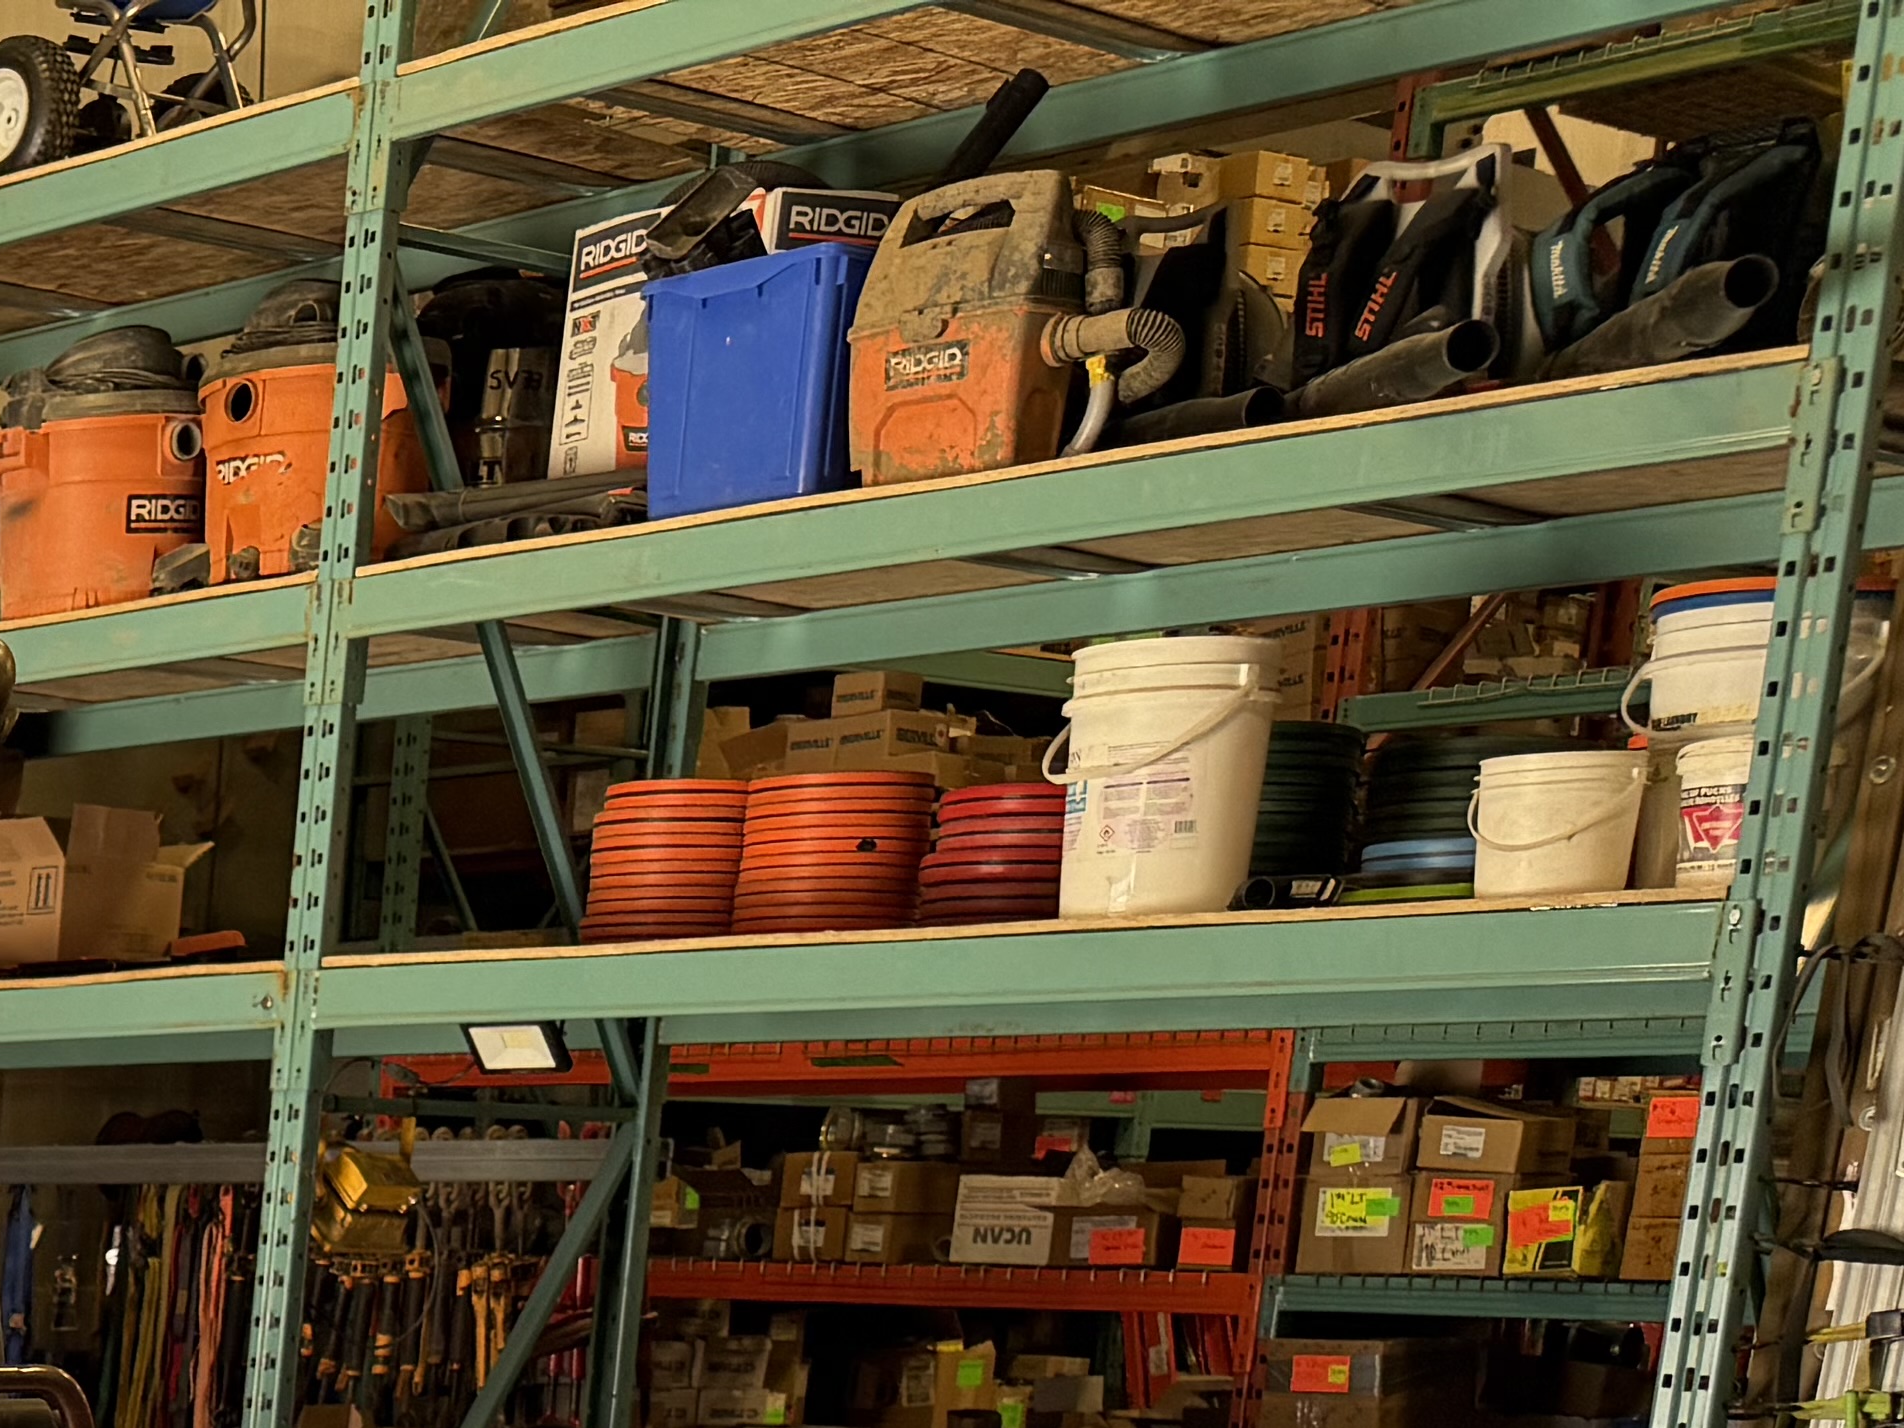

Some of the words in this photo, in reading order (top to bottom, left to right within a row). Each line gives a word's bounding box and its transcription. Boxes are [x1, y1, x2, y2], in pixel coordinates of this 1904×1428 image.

[789, 205, 890, 236] RIDGID
[581, 229, 647, 270] RIDGID
[1305, 273, 1328, 337] STIHL
[1355, 272, 1398, 341] STIHL
[890, 347, 962, 375] RIDGID
[130, 499, 199, 520] RIDGID
[972, 1227, 1032, 1245] UCAN
